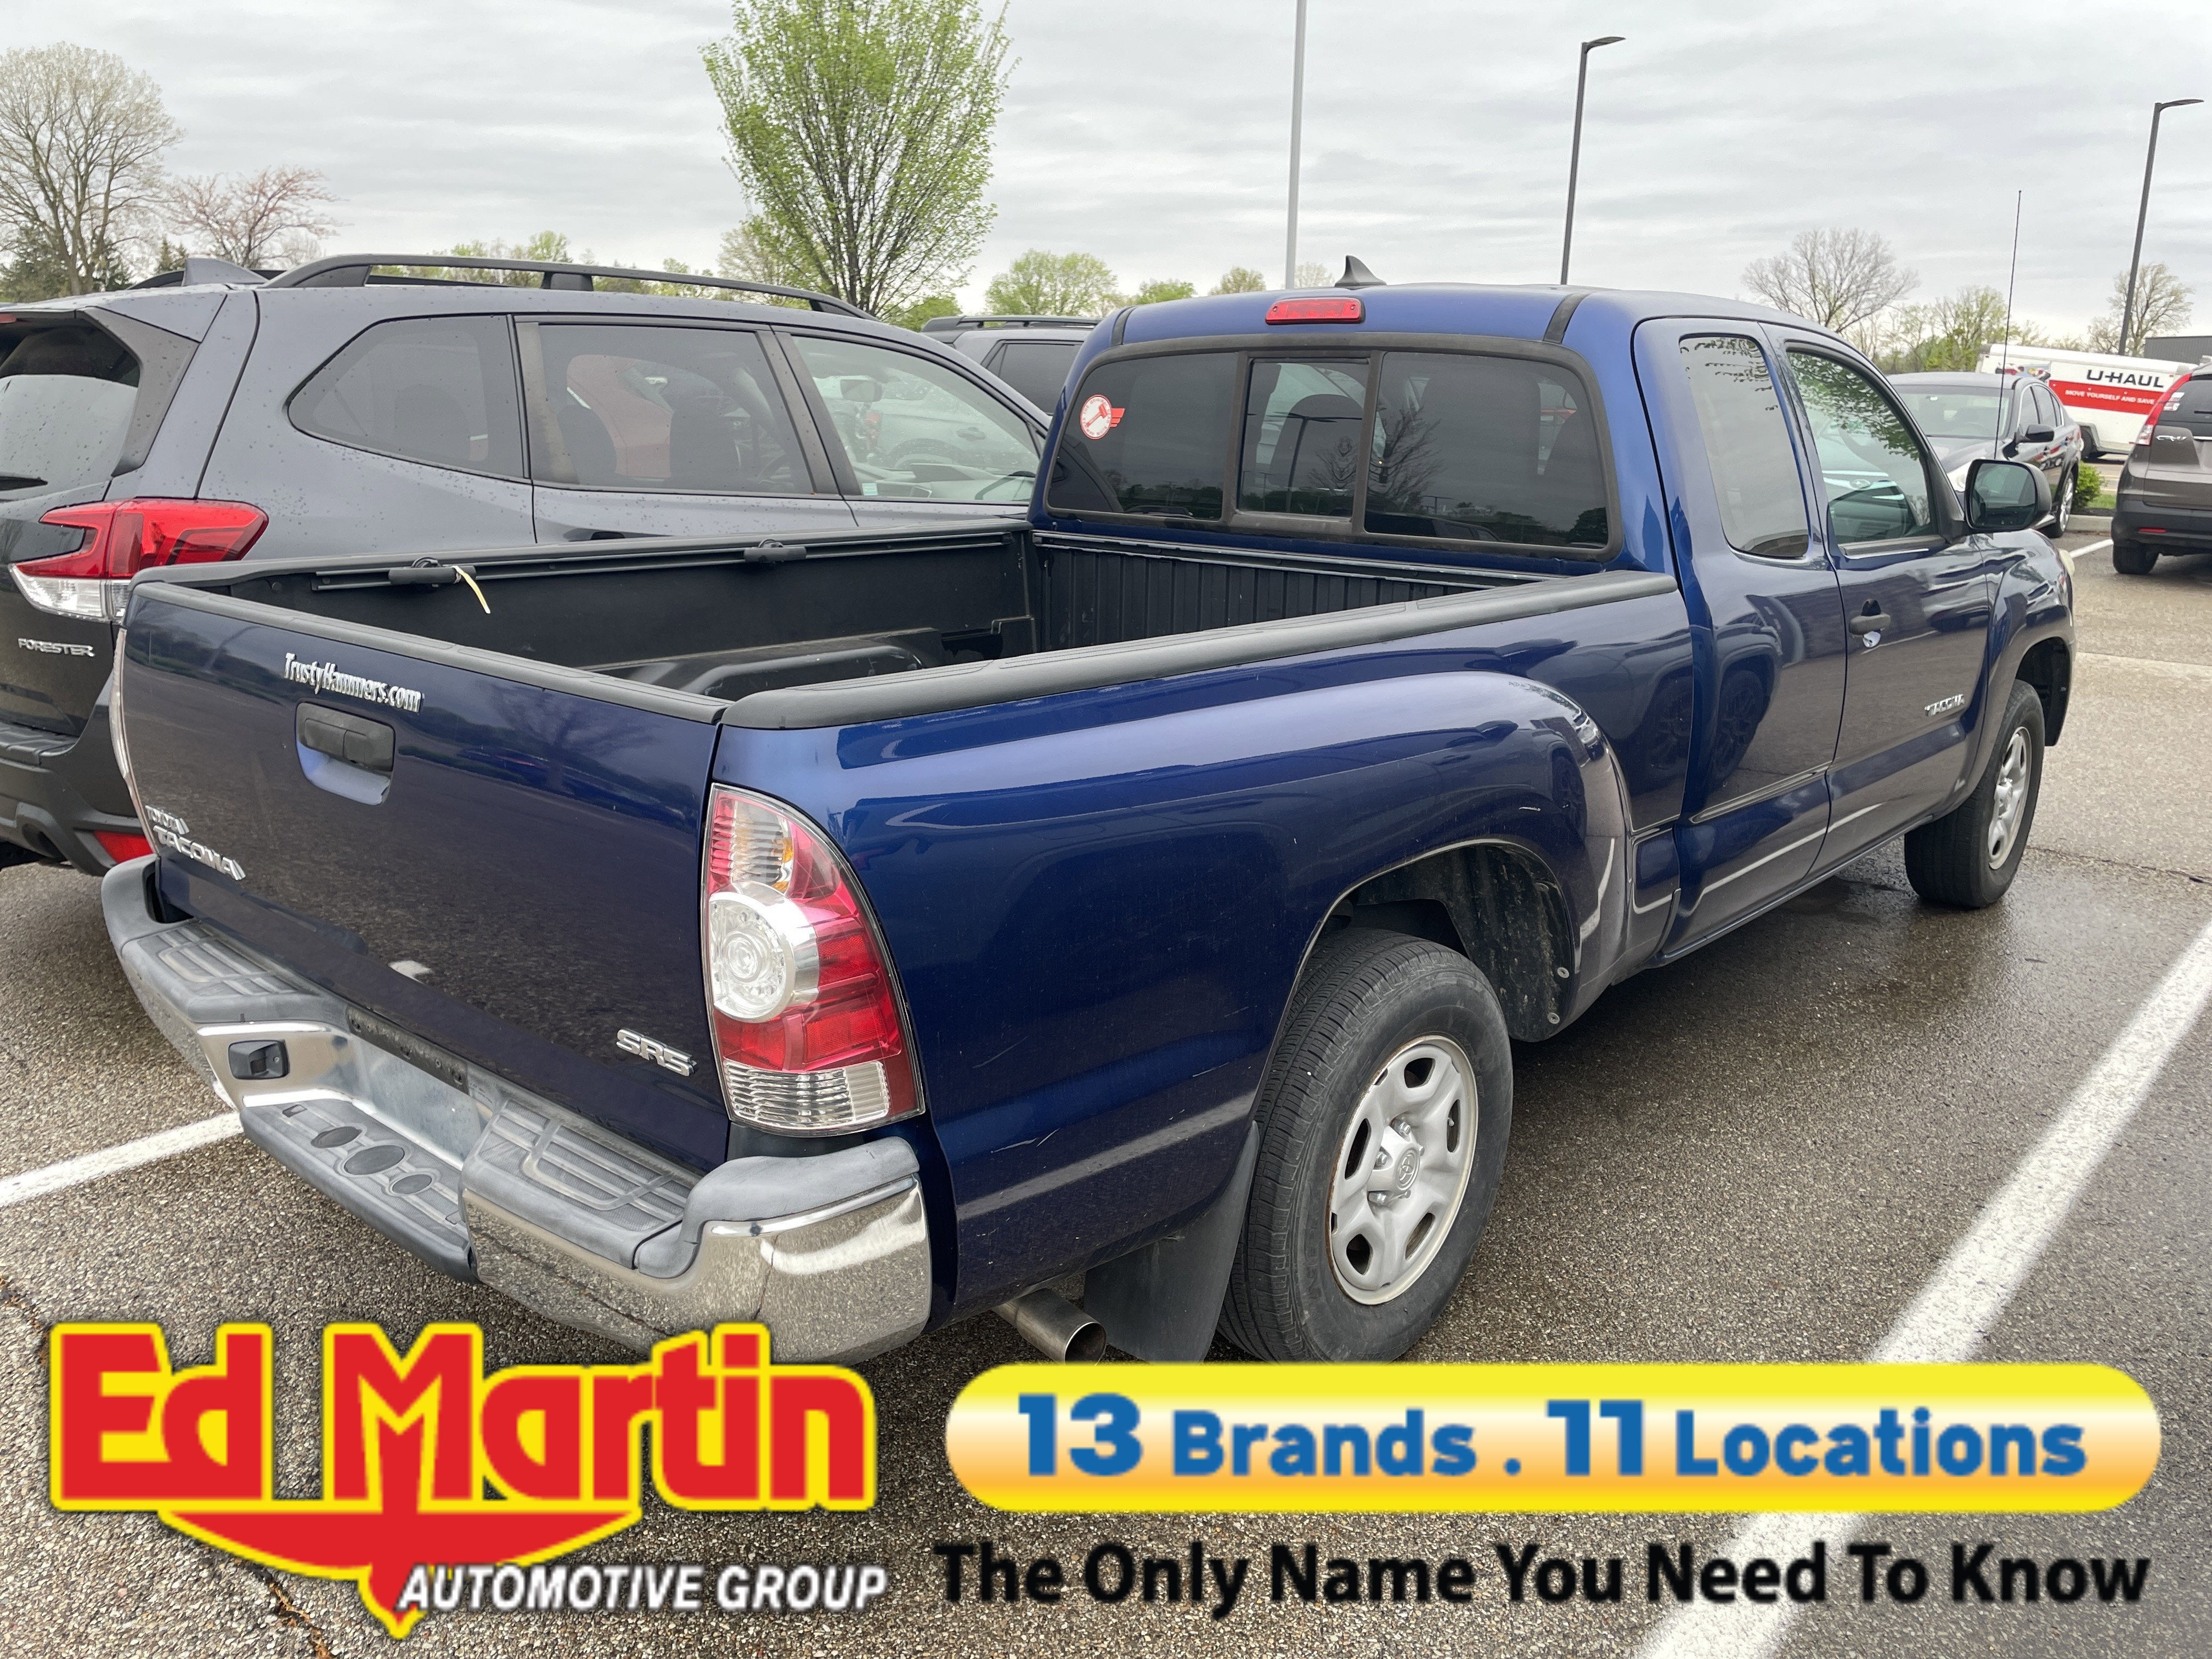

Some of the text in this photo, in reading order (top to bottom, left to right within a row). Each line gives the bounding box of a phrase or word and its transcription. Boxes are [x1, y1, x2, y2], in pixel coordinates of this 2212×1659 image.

[2086, 369, 2164, 388] U-HAUL
[2086, 392, 2121, 401] YOURSELF
[18, 637, 95, 657] FORESTER
[284, 652, 425, 713] TrustyHammers.com
[145, 805, 190, 835] TOYOTA
[153, 825, 246, 881] TACOMA
[616, 1028, 695, 1077] SR5
